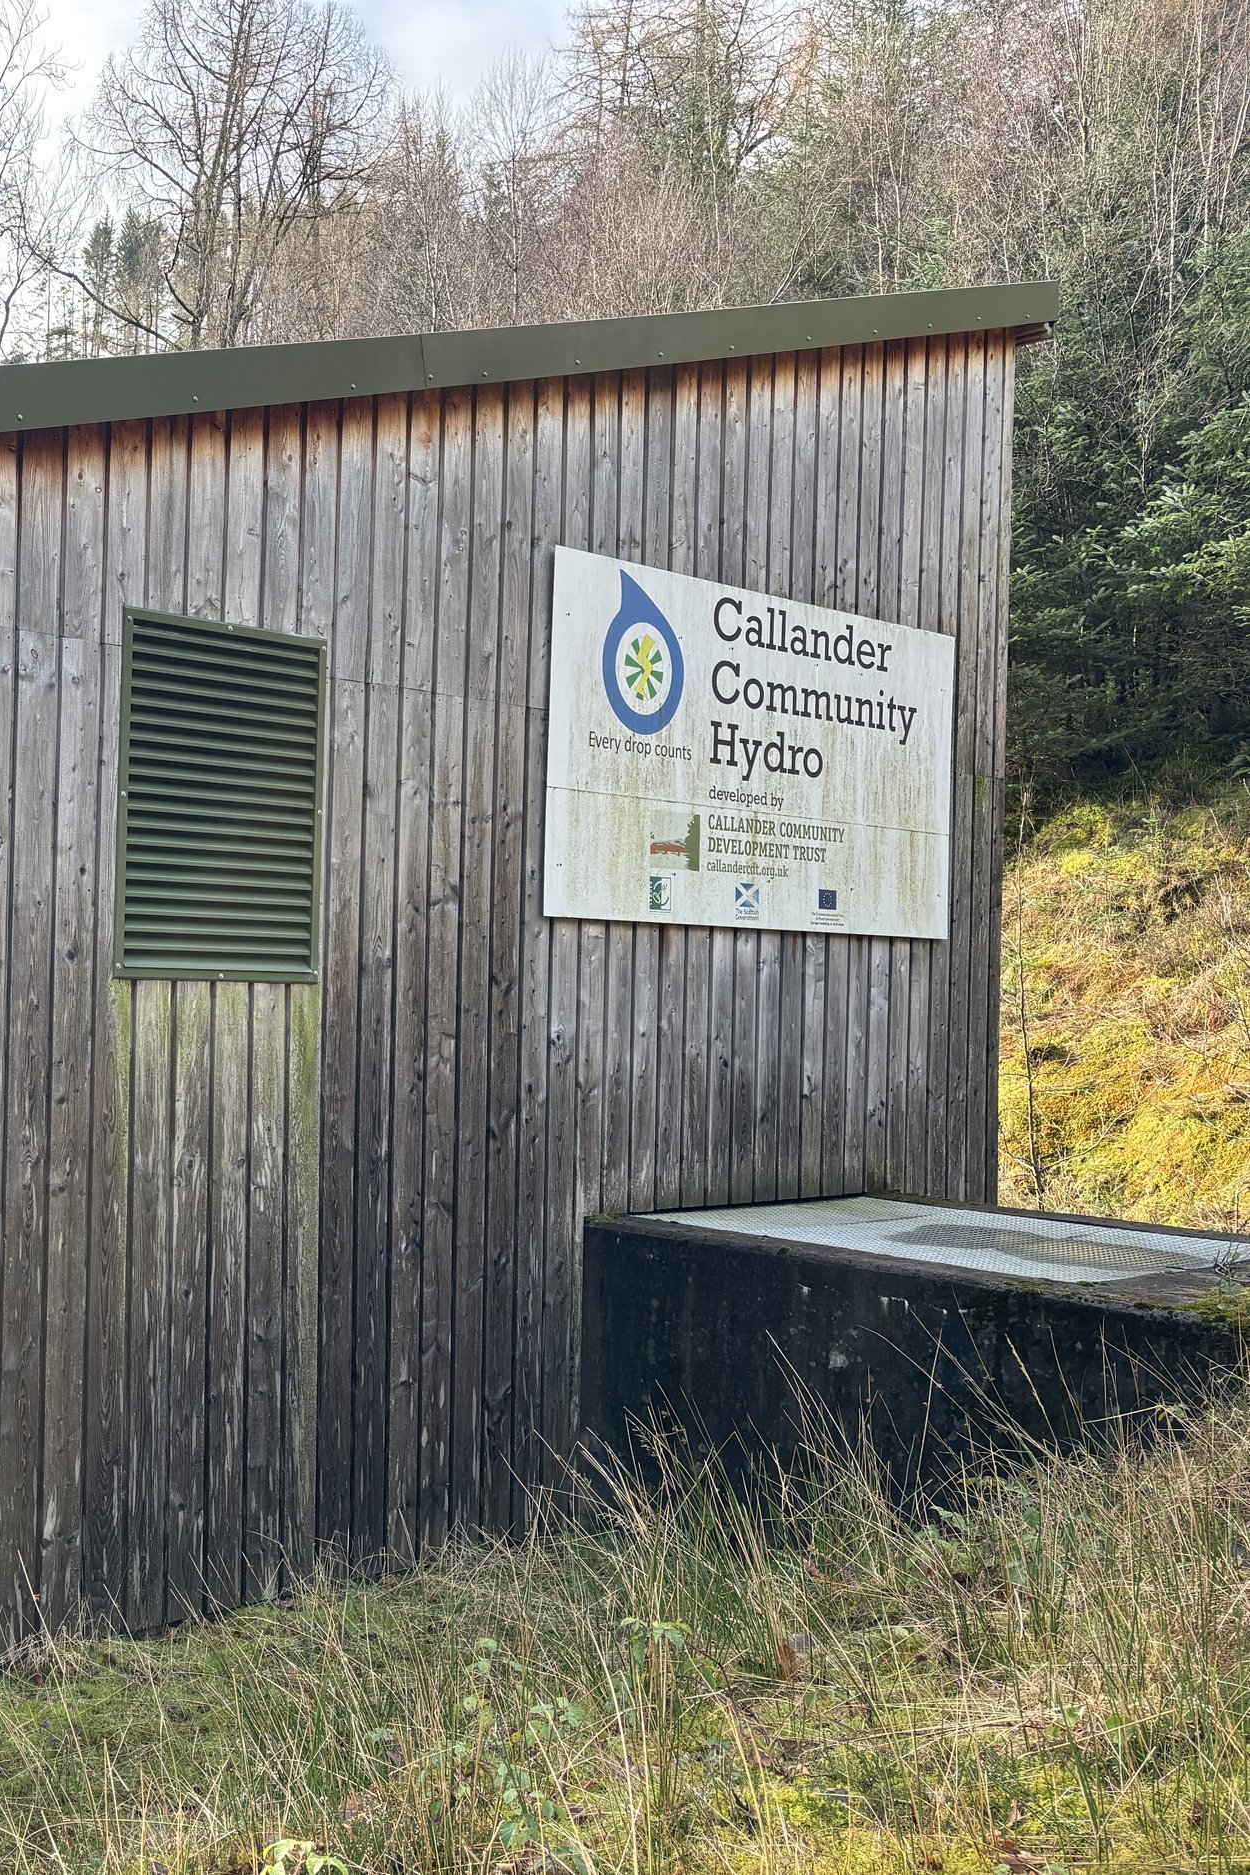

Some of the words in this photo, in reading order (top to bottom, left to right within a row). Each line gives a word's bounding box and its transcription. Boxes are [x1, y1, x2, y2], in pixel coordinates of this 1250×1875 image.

[713, 597, 892, 672] Callander
[711, 660, 917, 745] Community
[589, 731, 621, 754] Every
[624, 736, 651, 758] drop
[655, 743, 692, 760] counts
[709, 720, 823, 781] Hydro
[708, 786, 767, 807] developed
[770, 793, 784, 811] by
[708, 814, 776, 836] CALLANDER
[779, 822, 845, 843] COMMUNITY
[707, 837, 790, 859] DEVELOPMENT
[793, 845, 827, 863] TRUST
[706, 859, 789, 880] callandercdt.org.uk
